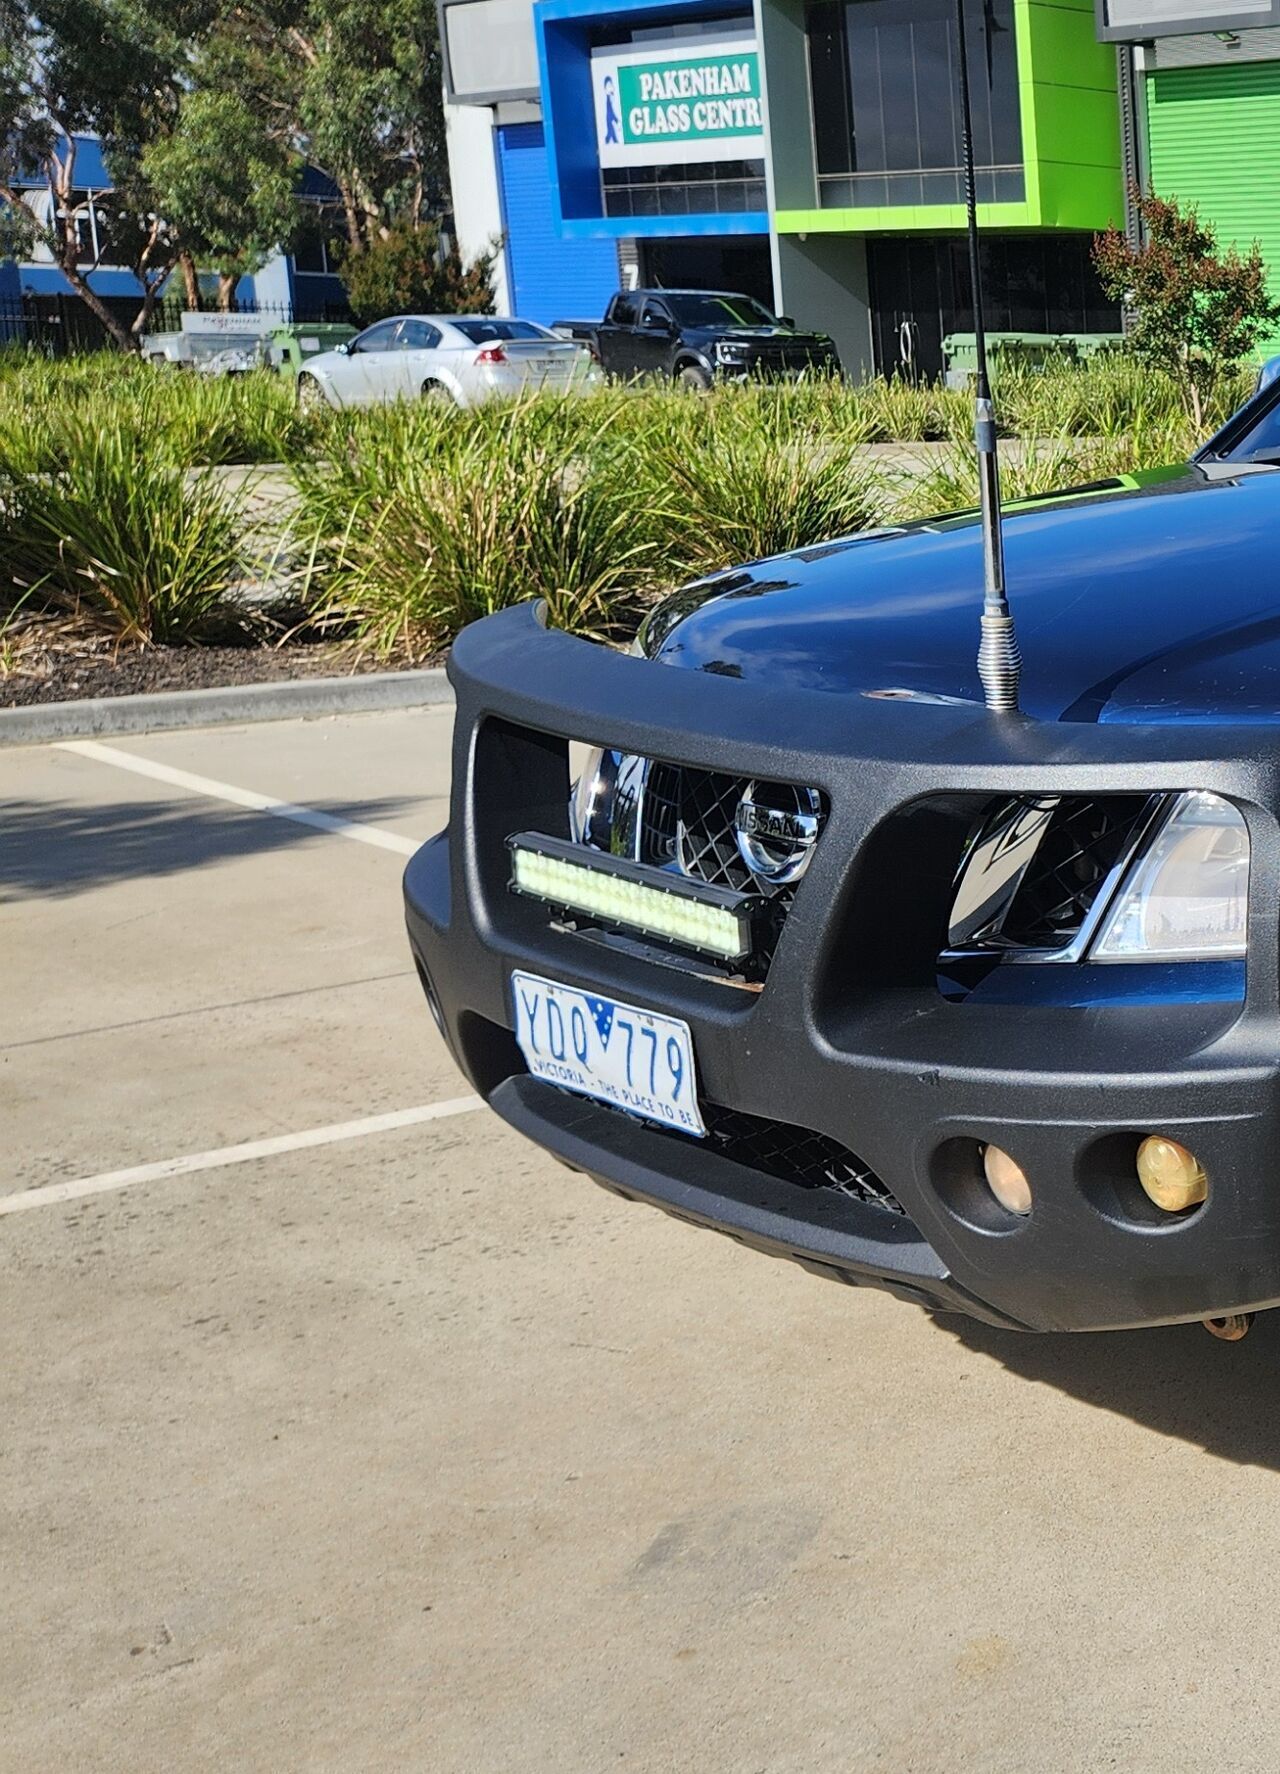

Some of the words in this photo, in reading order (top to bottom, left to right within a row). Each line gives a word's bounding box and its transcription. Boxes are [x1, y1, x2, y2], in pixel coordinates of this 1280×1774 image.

[639, 62, 752, 102] PAKENHAM
[629, 102, 691, 136] GLASS
[693, 97, 763, 131] CENTR
[520, 989, 593, 1074] YDQ
[617, 1019, 683, 1102] 779
[536, 1059, 585, 1086] VICTORIA
[598, 1079, 620, 1100] THE
[623, 1089, 655, 1113] PLACE
[658, 1102, 674, 1119] TO
[679, 1109, 693, 1127] BE
